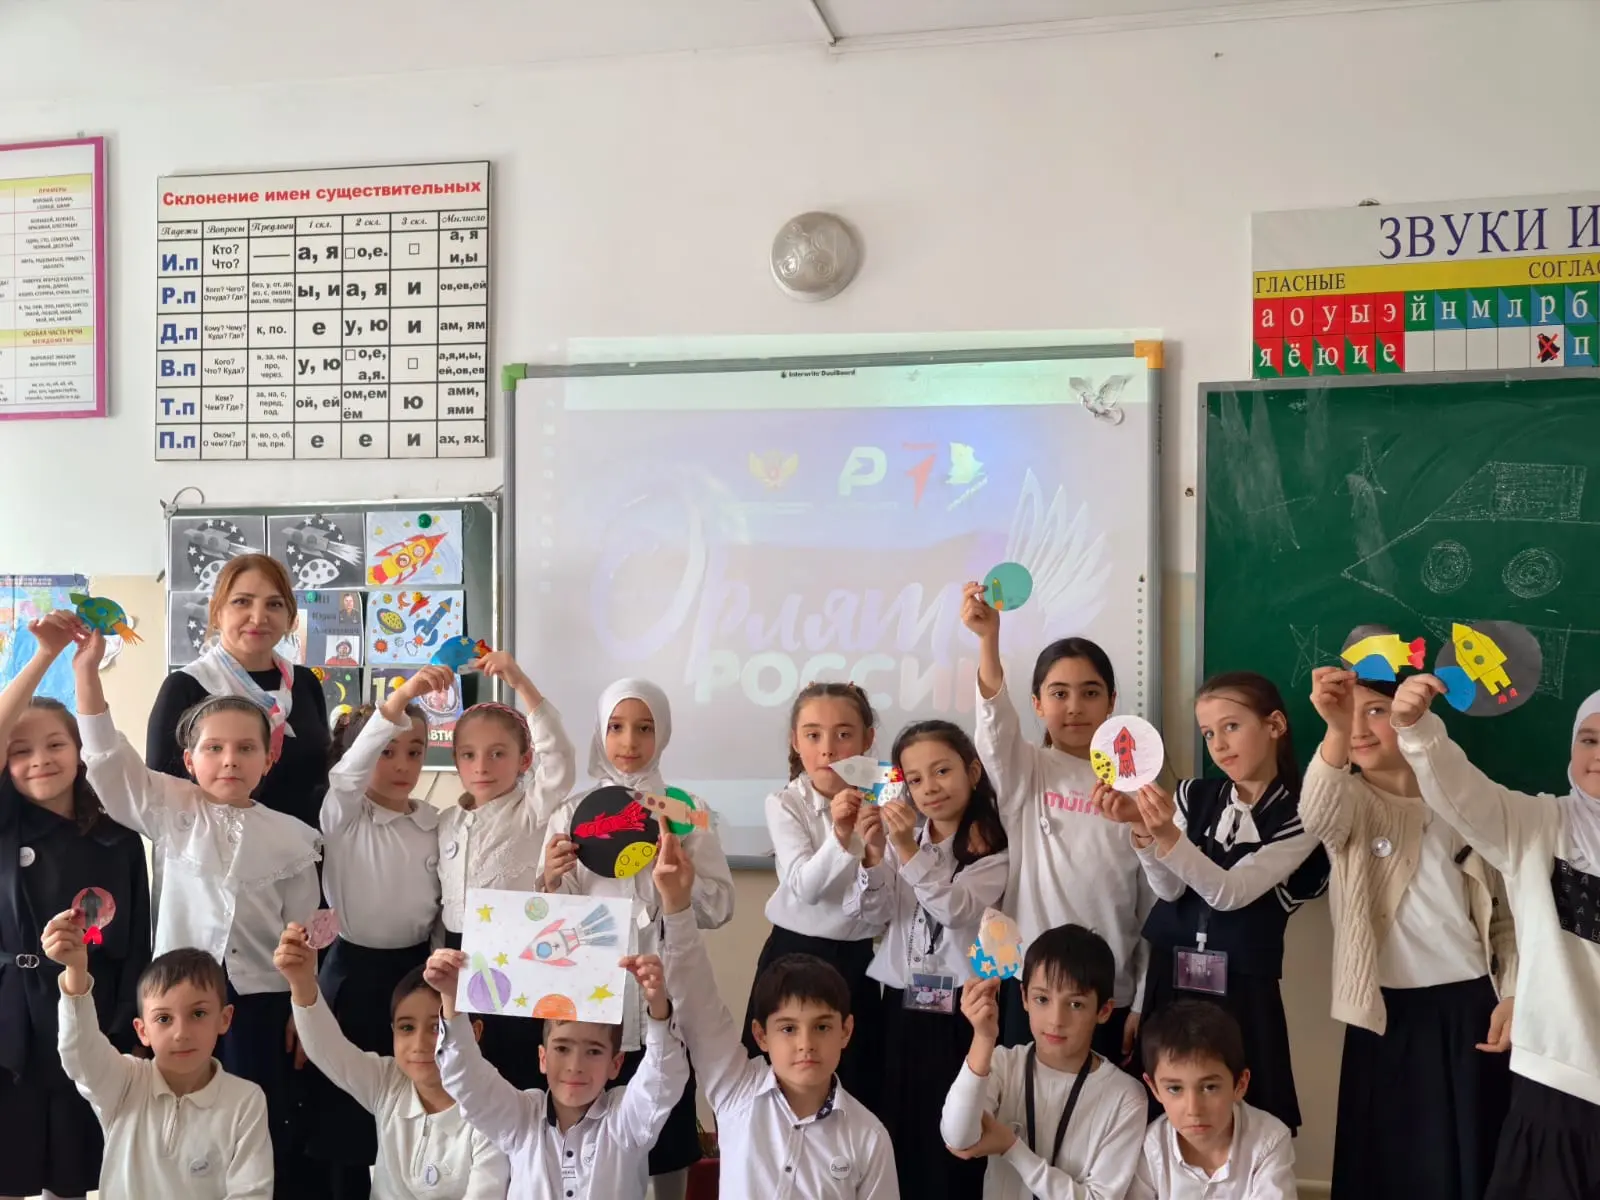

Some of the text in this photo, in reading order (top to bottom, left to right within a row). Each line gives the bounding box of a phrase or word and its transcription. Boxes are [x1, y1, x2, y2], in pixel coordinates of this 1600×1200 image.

[163, 181, 481, 206] Склонение имен существительных
[206, 224, 246, 236] Вопросы
[251, 222, 294, 234] Предлоги
[1379, 205, 1600, 260] ЗВУКИ И
[212, 244, 240, 255] Кто?
[162, 254, 199, 272] И.п
[212, 258, 240, 269] Что?
[408, 281, 422, 296] и
[1256, 273, 1346, 294] ГЛАСНЫЕ
[162, 287, 196, 305] Р.п
[312, 321, 326, 335] е
[408, 320, 422, 334] и
[467, 320, 485, 330] ям
[161, 323, 198, 344] Д.п
[161, 359, 196, 377] В.п
[214, 358, 235, 366] Кого?
[223, 366, 245, 375] Куда?
[160, 398, 195, 416] Т.п
[403, 395, 424, 409] ю
[343, 407, 363, 419] ём
[447, 405, 474, 415] ями
[159, 431, 196, 449] П.п
[311, 434, 325, 448] е
[358, 433, 373, 448] е
[407, 433, 421, 447] и
[590, 463, 1008, 690] Орлят
